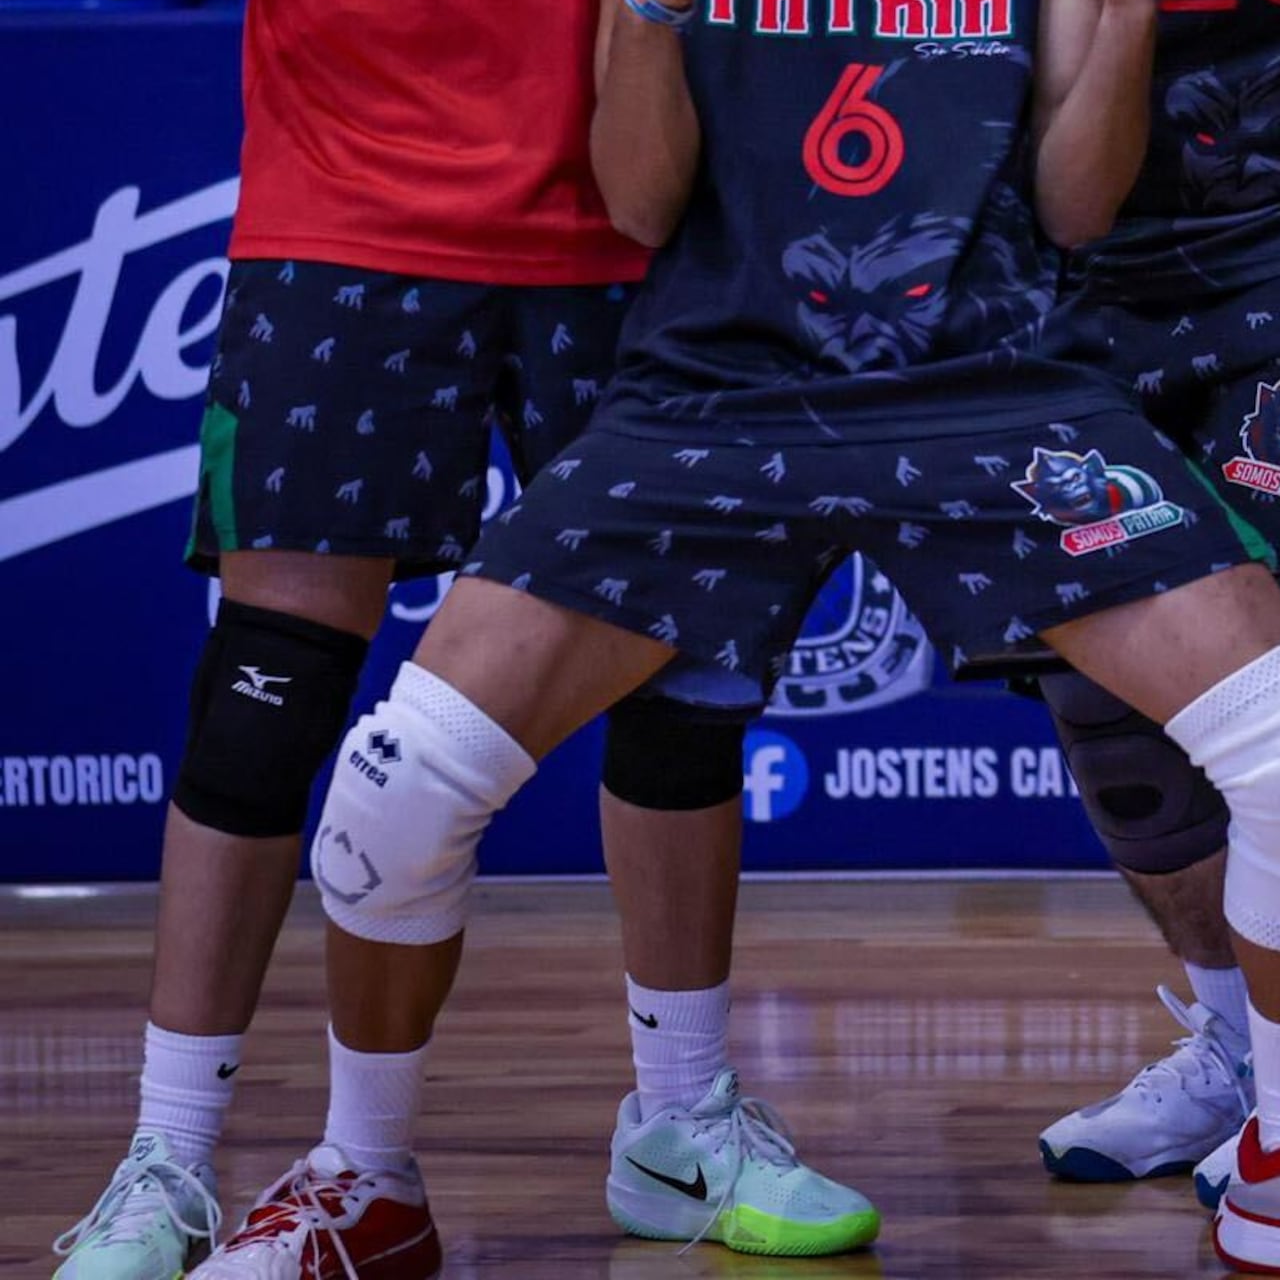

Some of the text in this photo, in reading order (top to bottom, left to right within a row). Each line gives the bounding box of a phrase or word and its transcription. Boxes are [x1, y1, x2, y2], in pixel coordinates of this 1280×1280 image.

[802, 62, 905, 198] 6
[1071, 505, 1175, 551] SOMOS PATRIA
[824, 746, 1081, 799] JOSTENS CA
